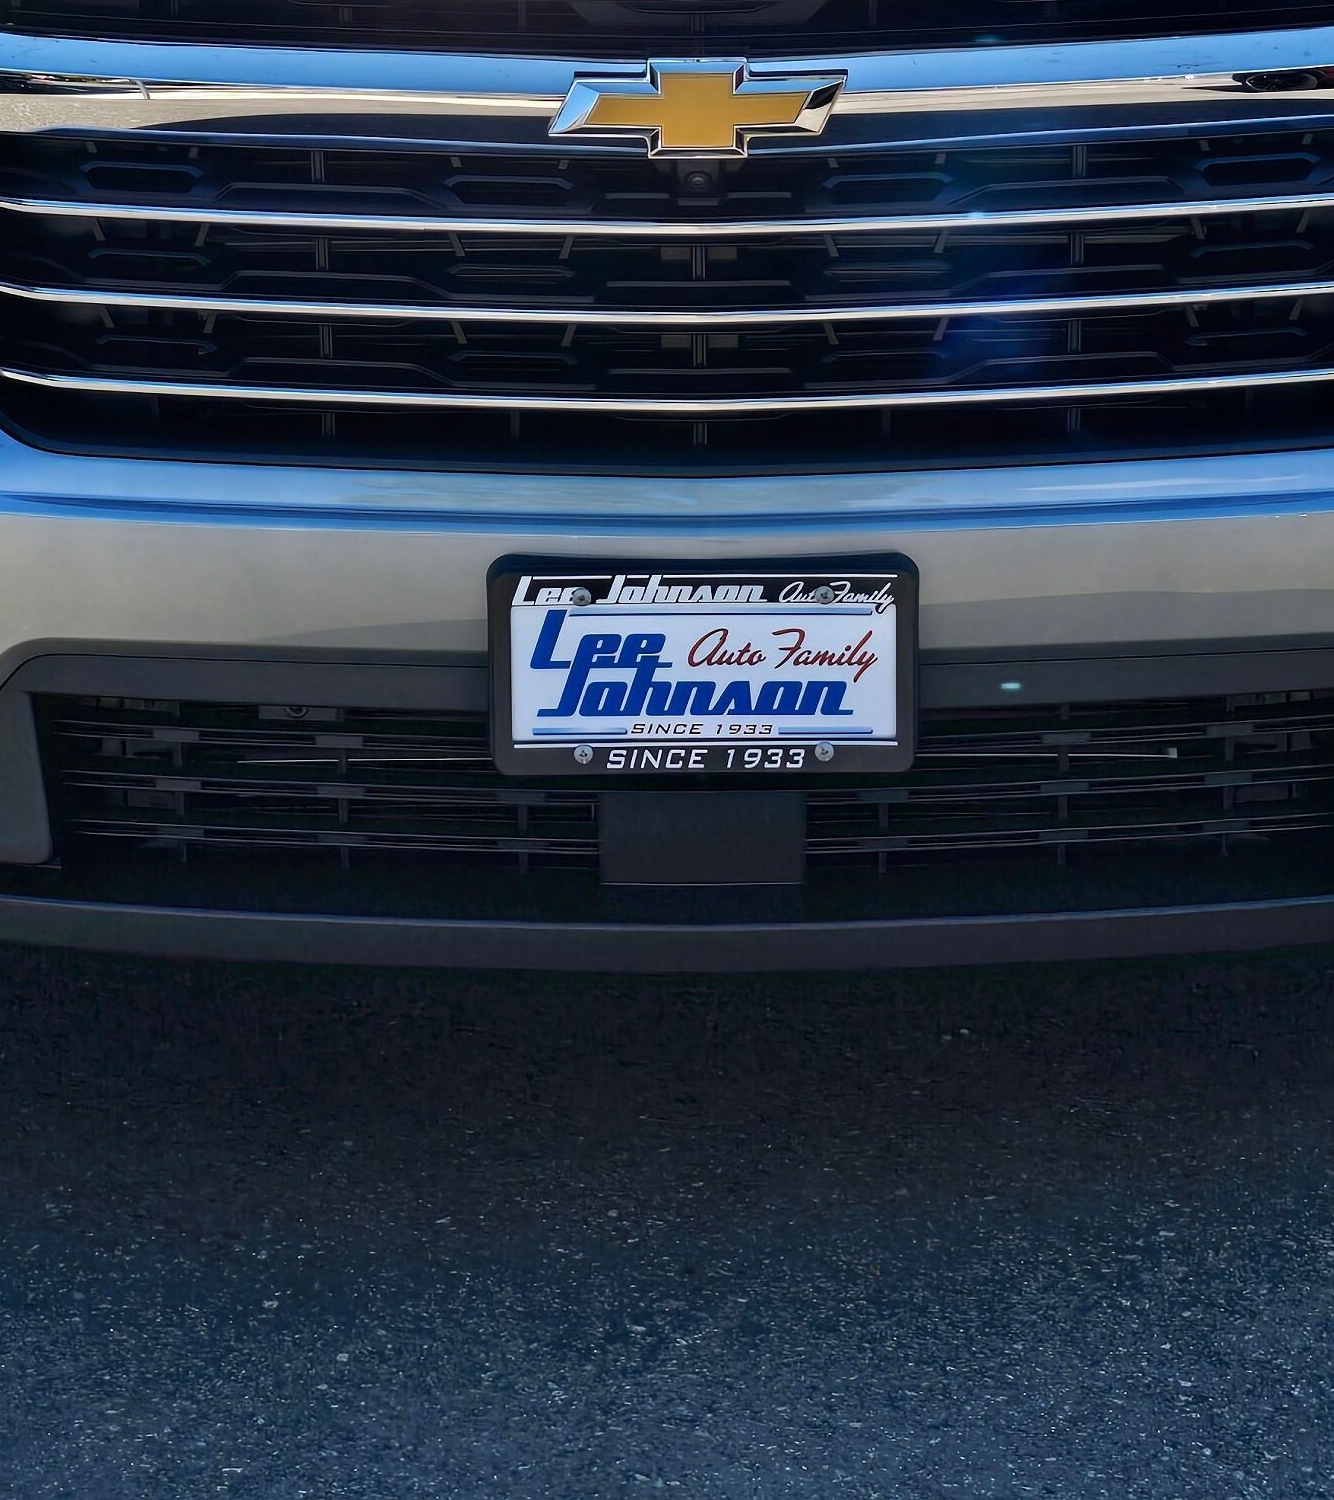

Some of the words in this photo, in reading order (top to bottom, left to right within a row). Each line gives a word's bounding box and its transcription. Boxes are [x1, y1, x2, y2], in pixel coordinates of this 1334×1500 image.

[596, 574, 767, 604] Johnson
[530, 610, 673, 669] Lee
[687, 628, 766, 667] Auto
[772, 628, 878, 683] Family
[537, 662, 854, 717] Johnson
[631, 723, 703, 735] SINCE
[716, 724, 773, 735] 1933
[607, 749, 708, 769] SINCE
[727, 749, 805, 769] 1933
